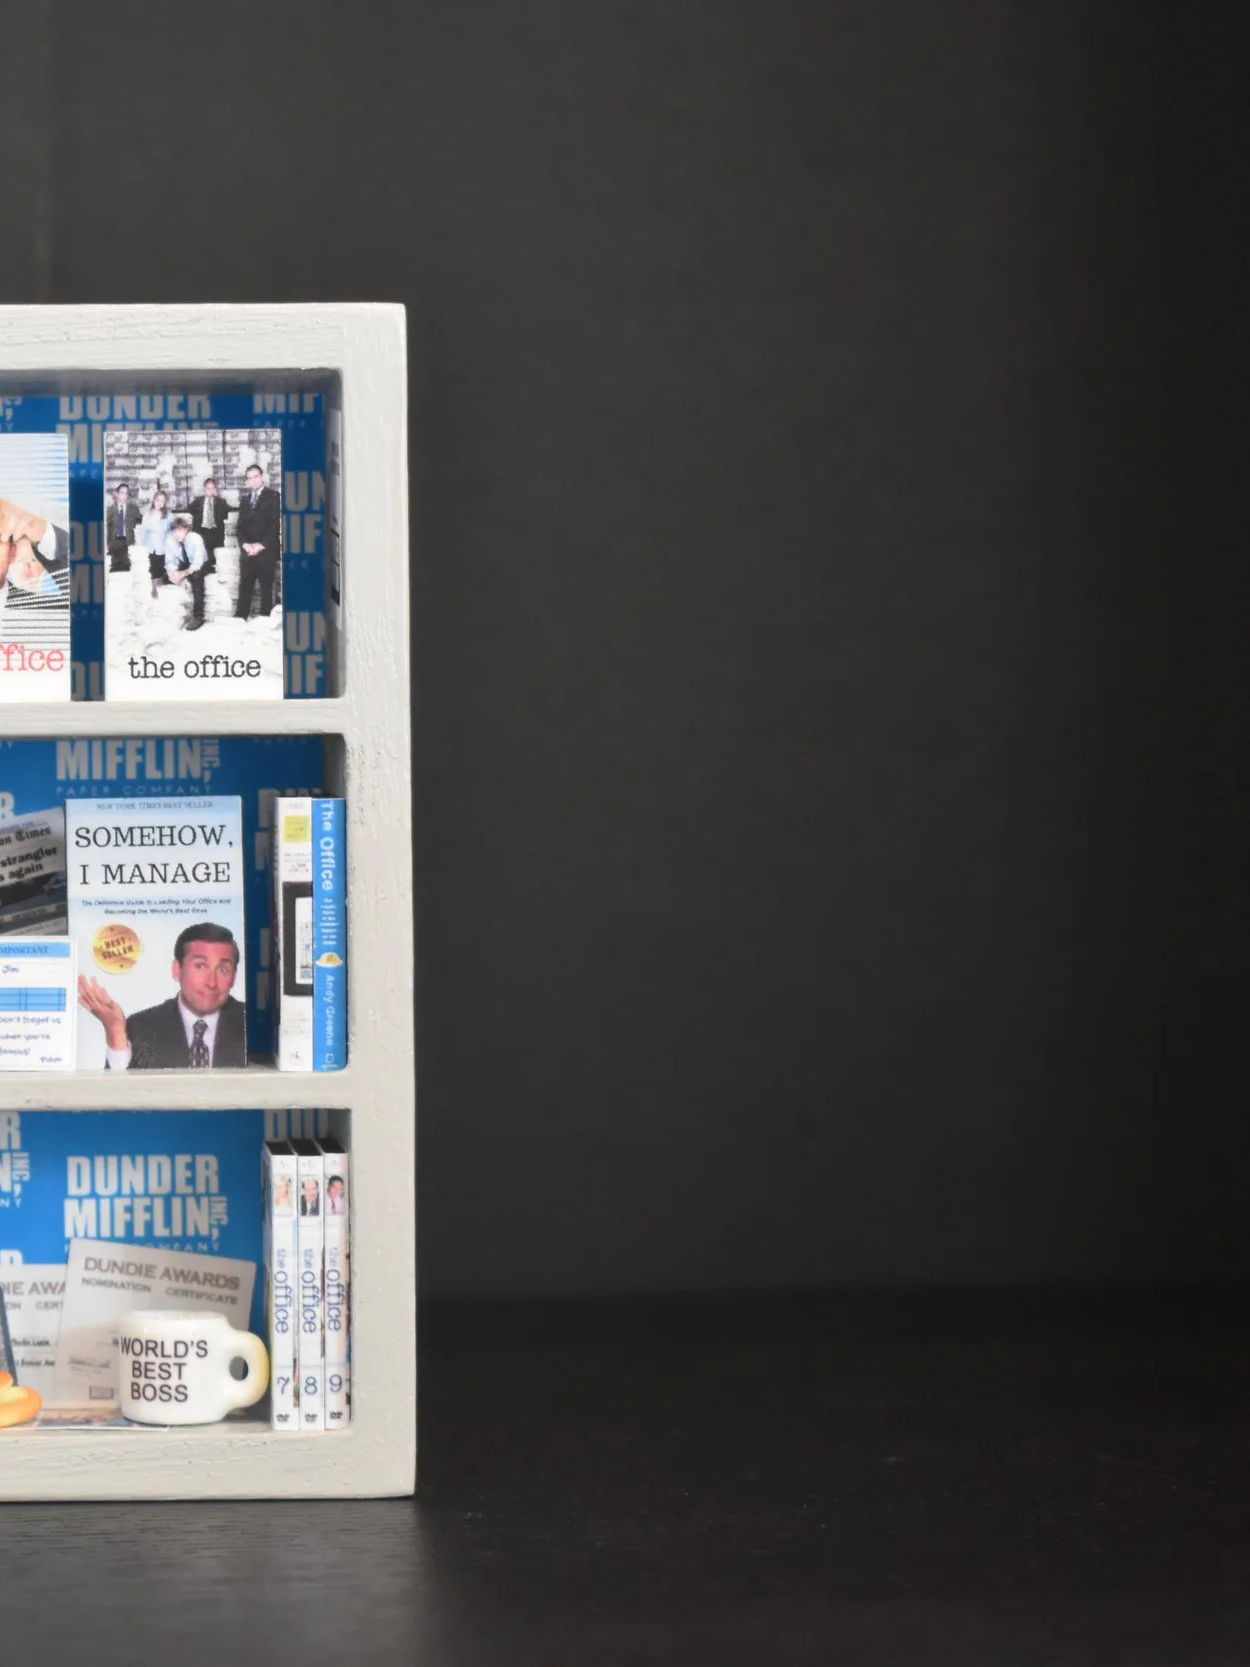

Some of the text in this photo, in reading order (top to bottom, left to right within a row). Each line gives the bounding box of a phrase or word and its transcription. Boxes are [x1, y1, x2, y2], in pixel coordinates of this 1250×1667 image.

[128, 656, 174, 679] the
[184, 655, 260, 679] office
[56, 785, 211, 795] PAPER COMPANY
[321, 800, 334, 832] The
[15, 827, 51, 841] Times
[75, 825, 233, 848] SOMEHOW,
[0, 847, 57, 868] strangler
[320, 836, 336, 892] Office
[9, 863, 43, 880] again
[80, 862, 230, 885] I MANAGE
[104, 936, 127, 950] BEST
[2, 965, 19, 974] Jim
[67, 1154, 219, 1196] DUNDER
[84, 1257, 241, 1291] DUNDIE AWARDS
[81, 1277, 238, 1305] NOMINATION CERTIFICATE
[274, 1271, 294, 1334] office
[301, 1270, 320, 1334] office
[326, 1269, 345, 1332] office
[120, 1336, 208, 1359] WORLD'S
[132, 1360, 187, 1380] BEST
[131, 1382, 188, 1403] BOSS
[277, 1376, 290, 1395] 7
[304, 1376, 317, 1395] 8
[329, 1374, 343, 1393] 9
